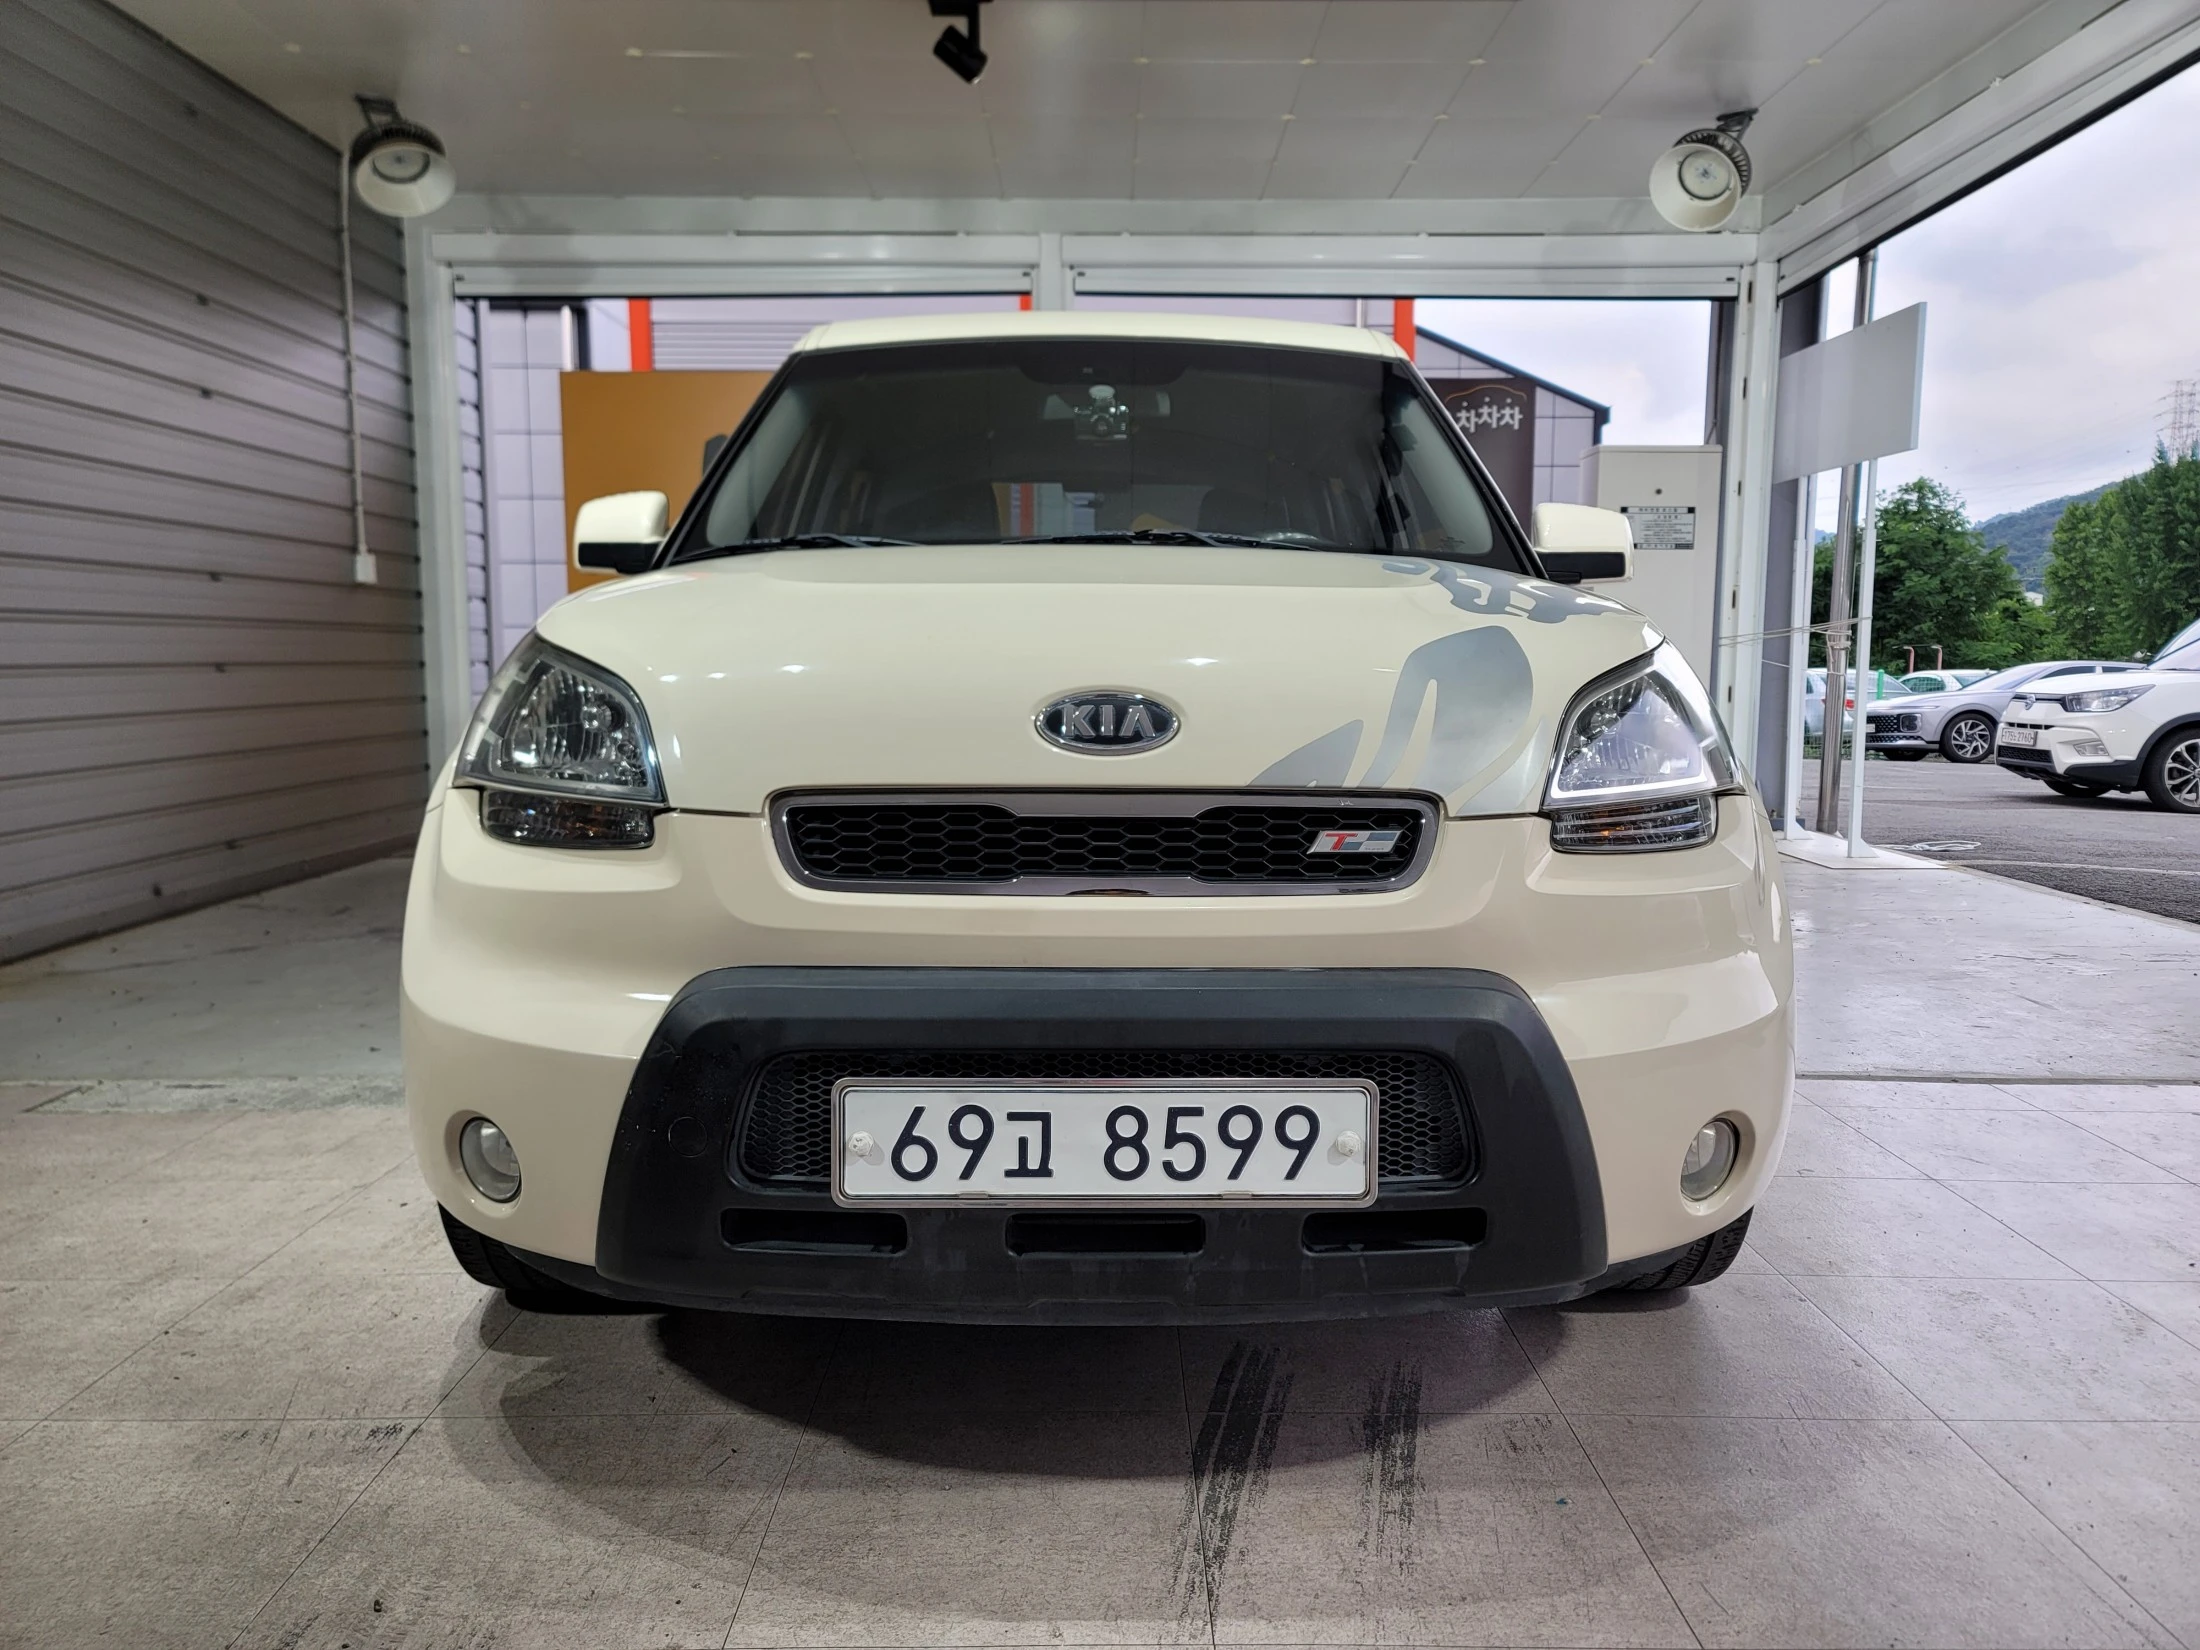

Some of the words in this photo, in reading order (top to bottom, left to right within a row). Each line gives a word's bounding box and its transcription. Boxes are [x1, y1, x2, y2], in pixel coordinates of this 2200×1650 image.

[1456, 396, 1523, 433] 차차차
[1061, 704, 1157, 739] KIA
[1324, 832, 1358, 851] T
[890, 1104, 1054, 1182] 69고
[1103, 1104, 1321, 1182] 8599
